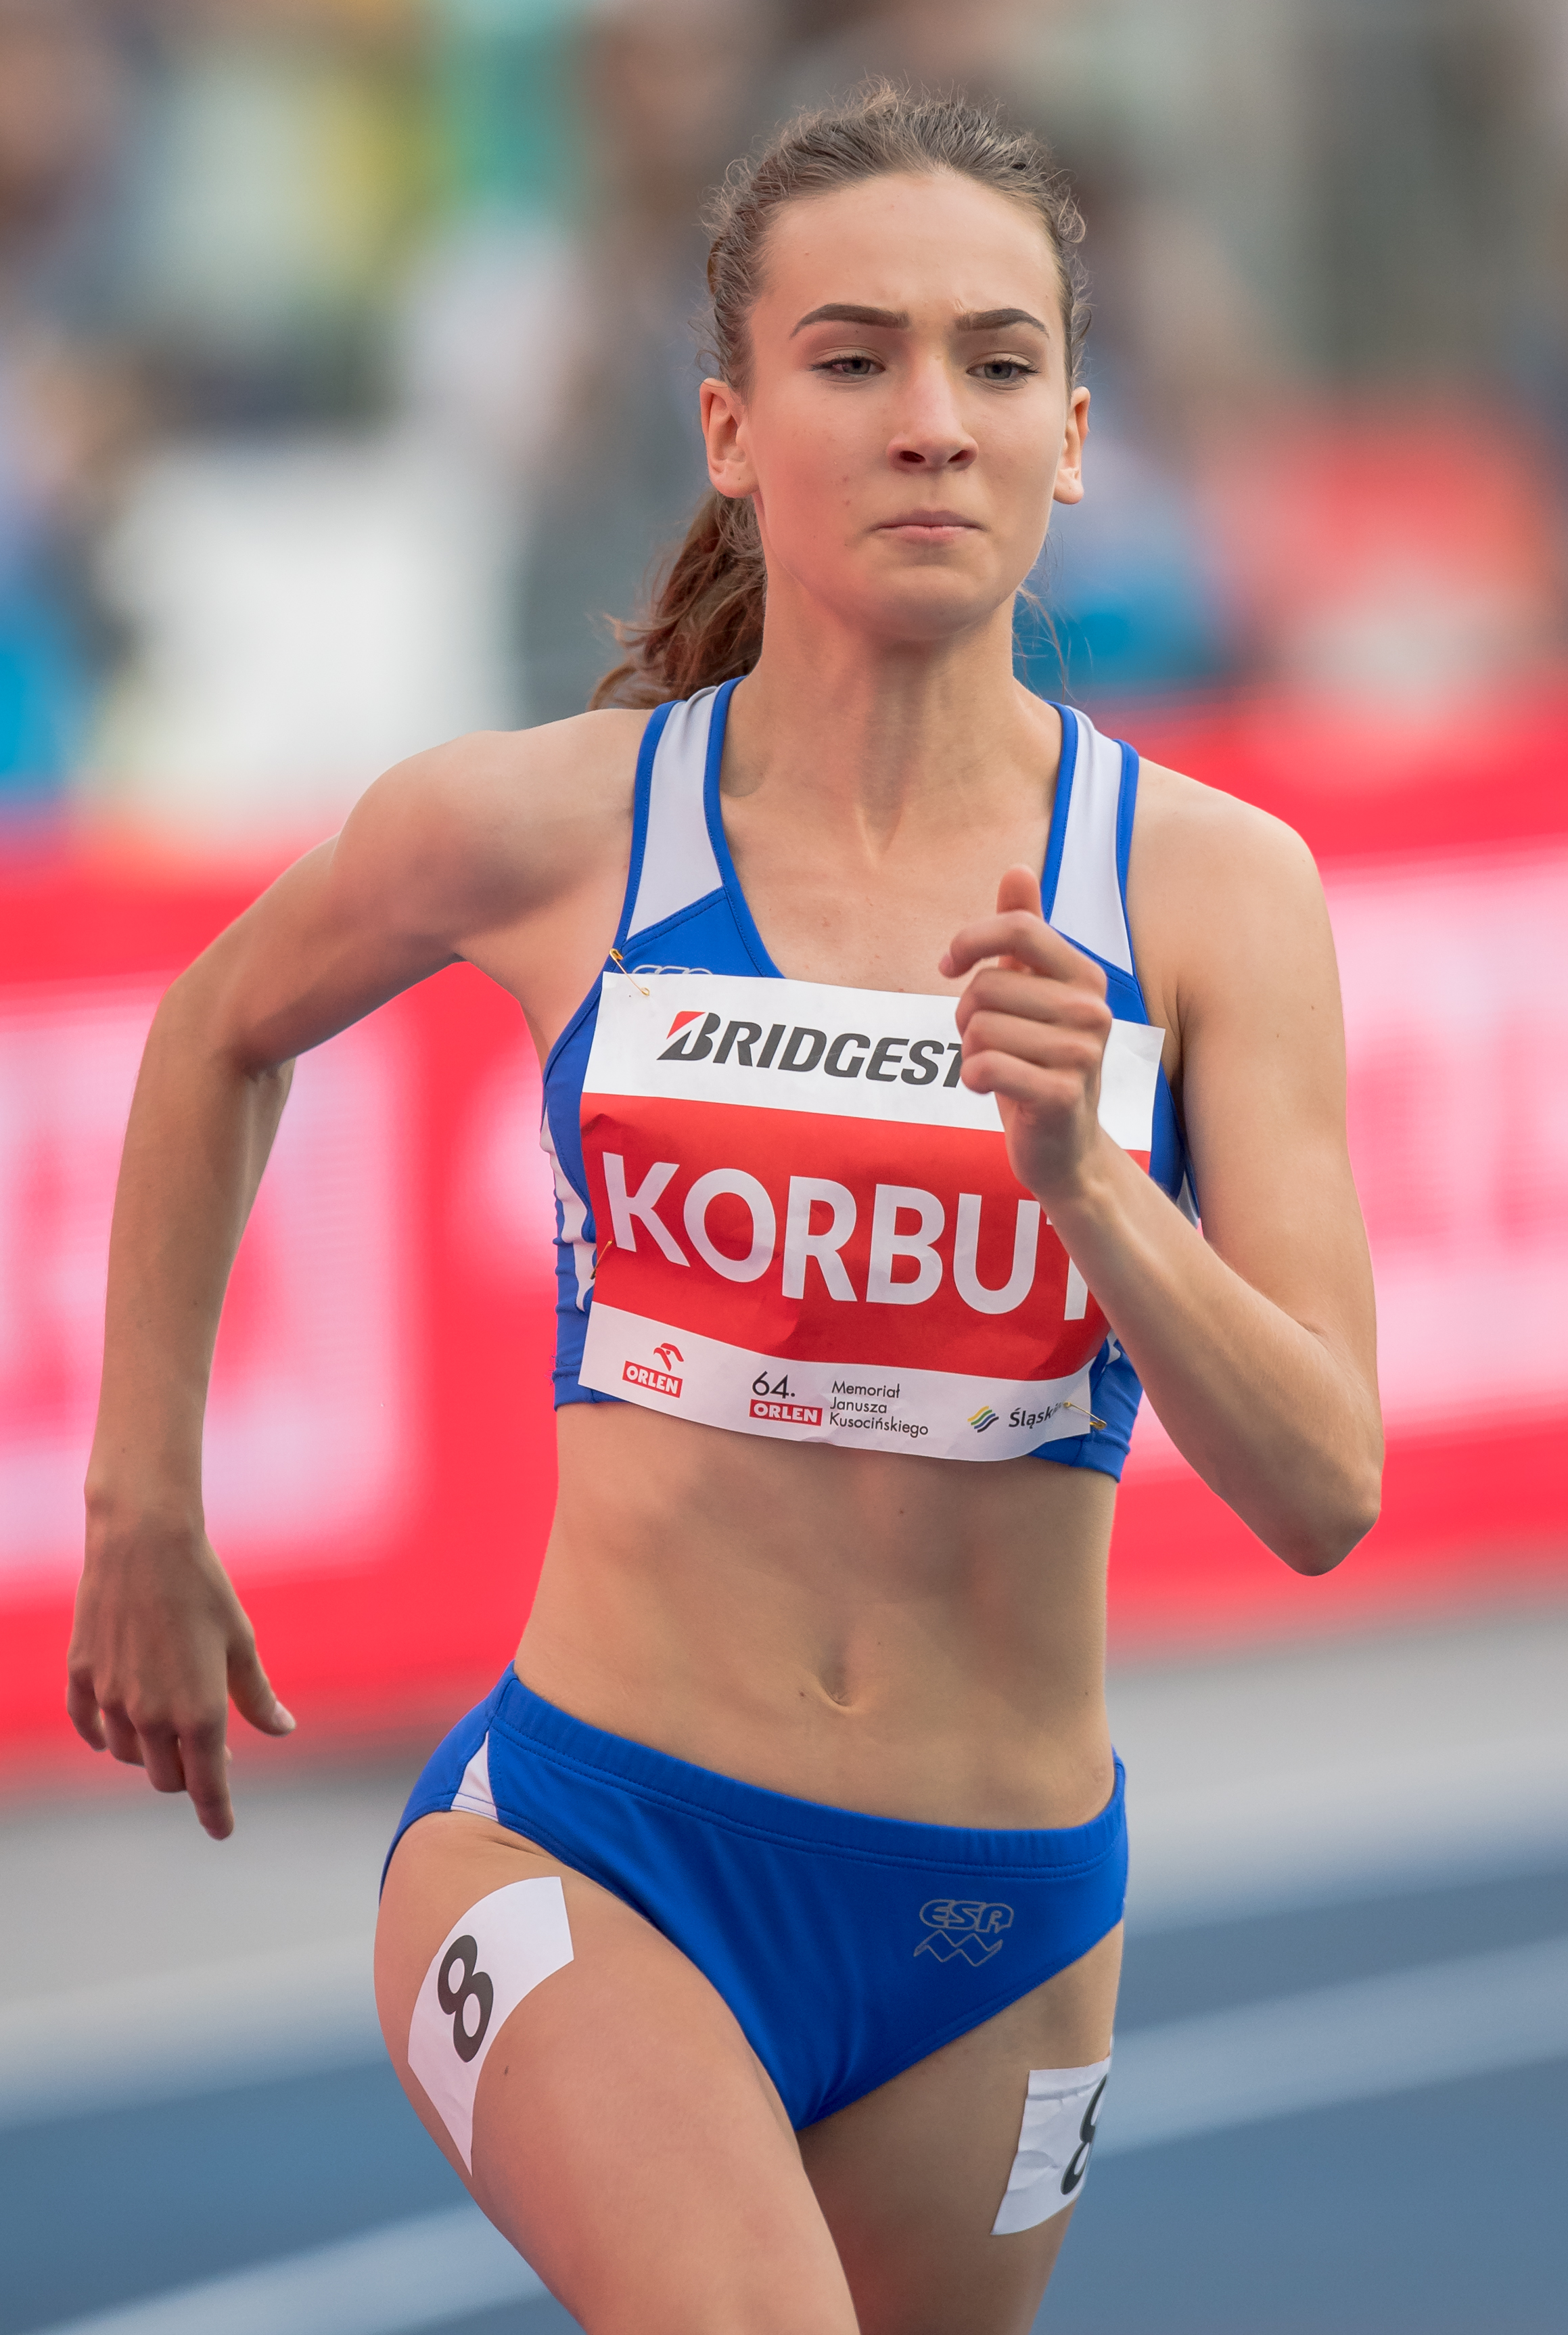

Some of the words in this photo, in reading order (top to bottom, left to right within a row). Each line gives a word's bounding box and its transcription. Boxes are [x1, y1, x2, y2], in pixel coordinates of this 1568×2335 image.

[626, 1365, 679, 1395] ORLEN
[752, 1370, 796, 1399] 64.
[831, 1380, 900, 1399] Memoriał
[753, 1403, 818, 1423] ORLEN
[829, 1396, 887, 1414] Janusza
[829, 1411, 929, 1438] Kusocińskiego
[437, 1934, 494, 2064] 8
